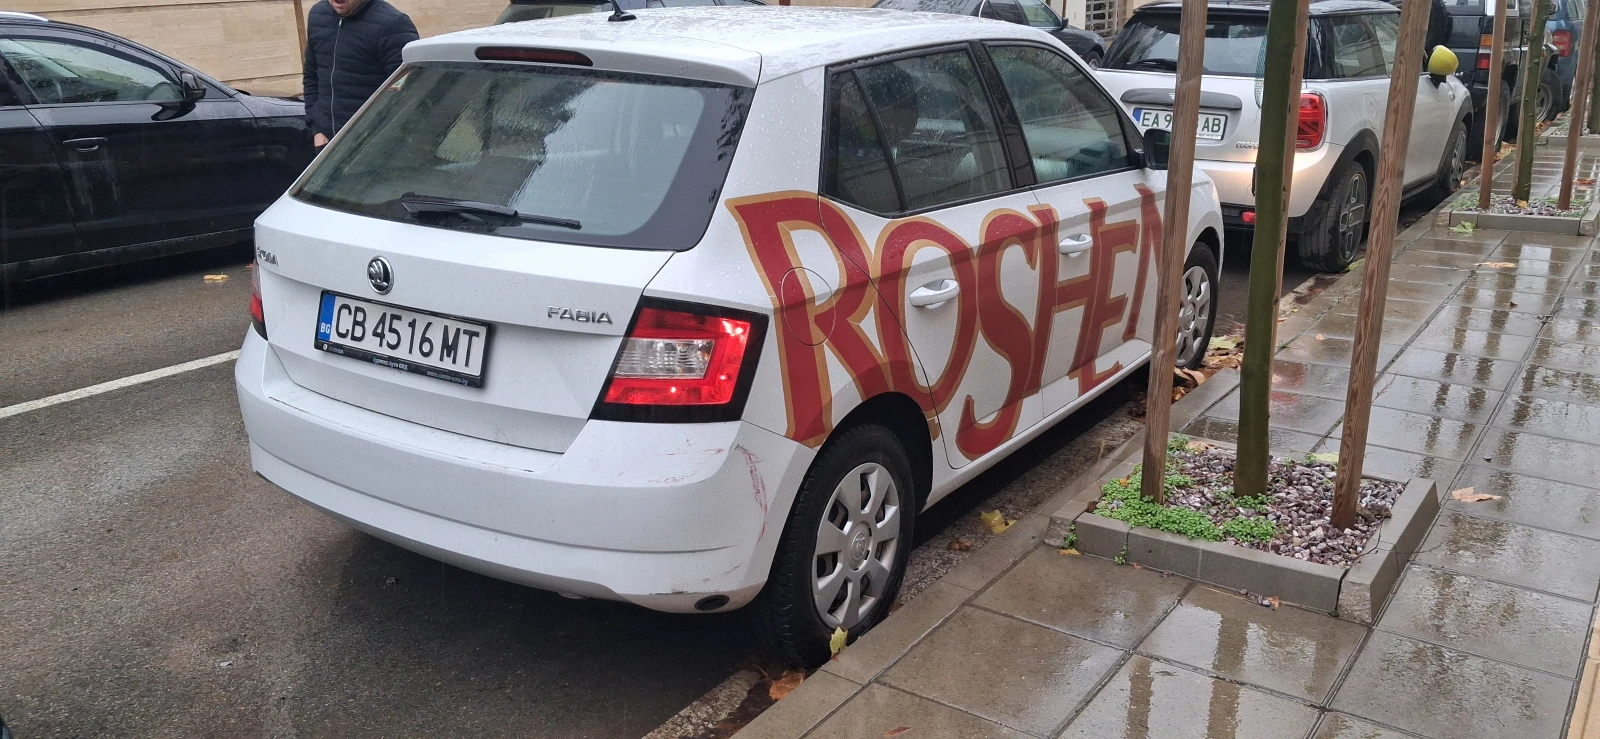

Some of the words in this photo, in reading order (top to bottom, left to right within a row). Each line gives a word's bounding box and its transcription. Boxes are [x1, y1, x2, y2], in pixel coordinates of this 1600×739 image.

[1141, 111, 1160, 128] EA
[1201, 116, 1221, 133] AB
[1235, 140, 1259, 150] COOPE
[547, 305, 614, 325] FABIA
[320, 322, 331, 334] BG
[335, 303, 367, 343] CB
[372, 310, 434, 358] 4516
[439, 324, 480, 368] MT
